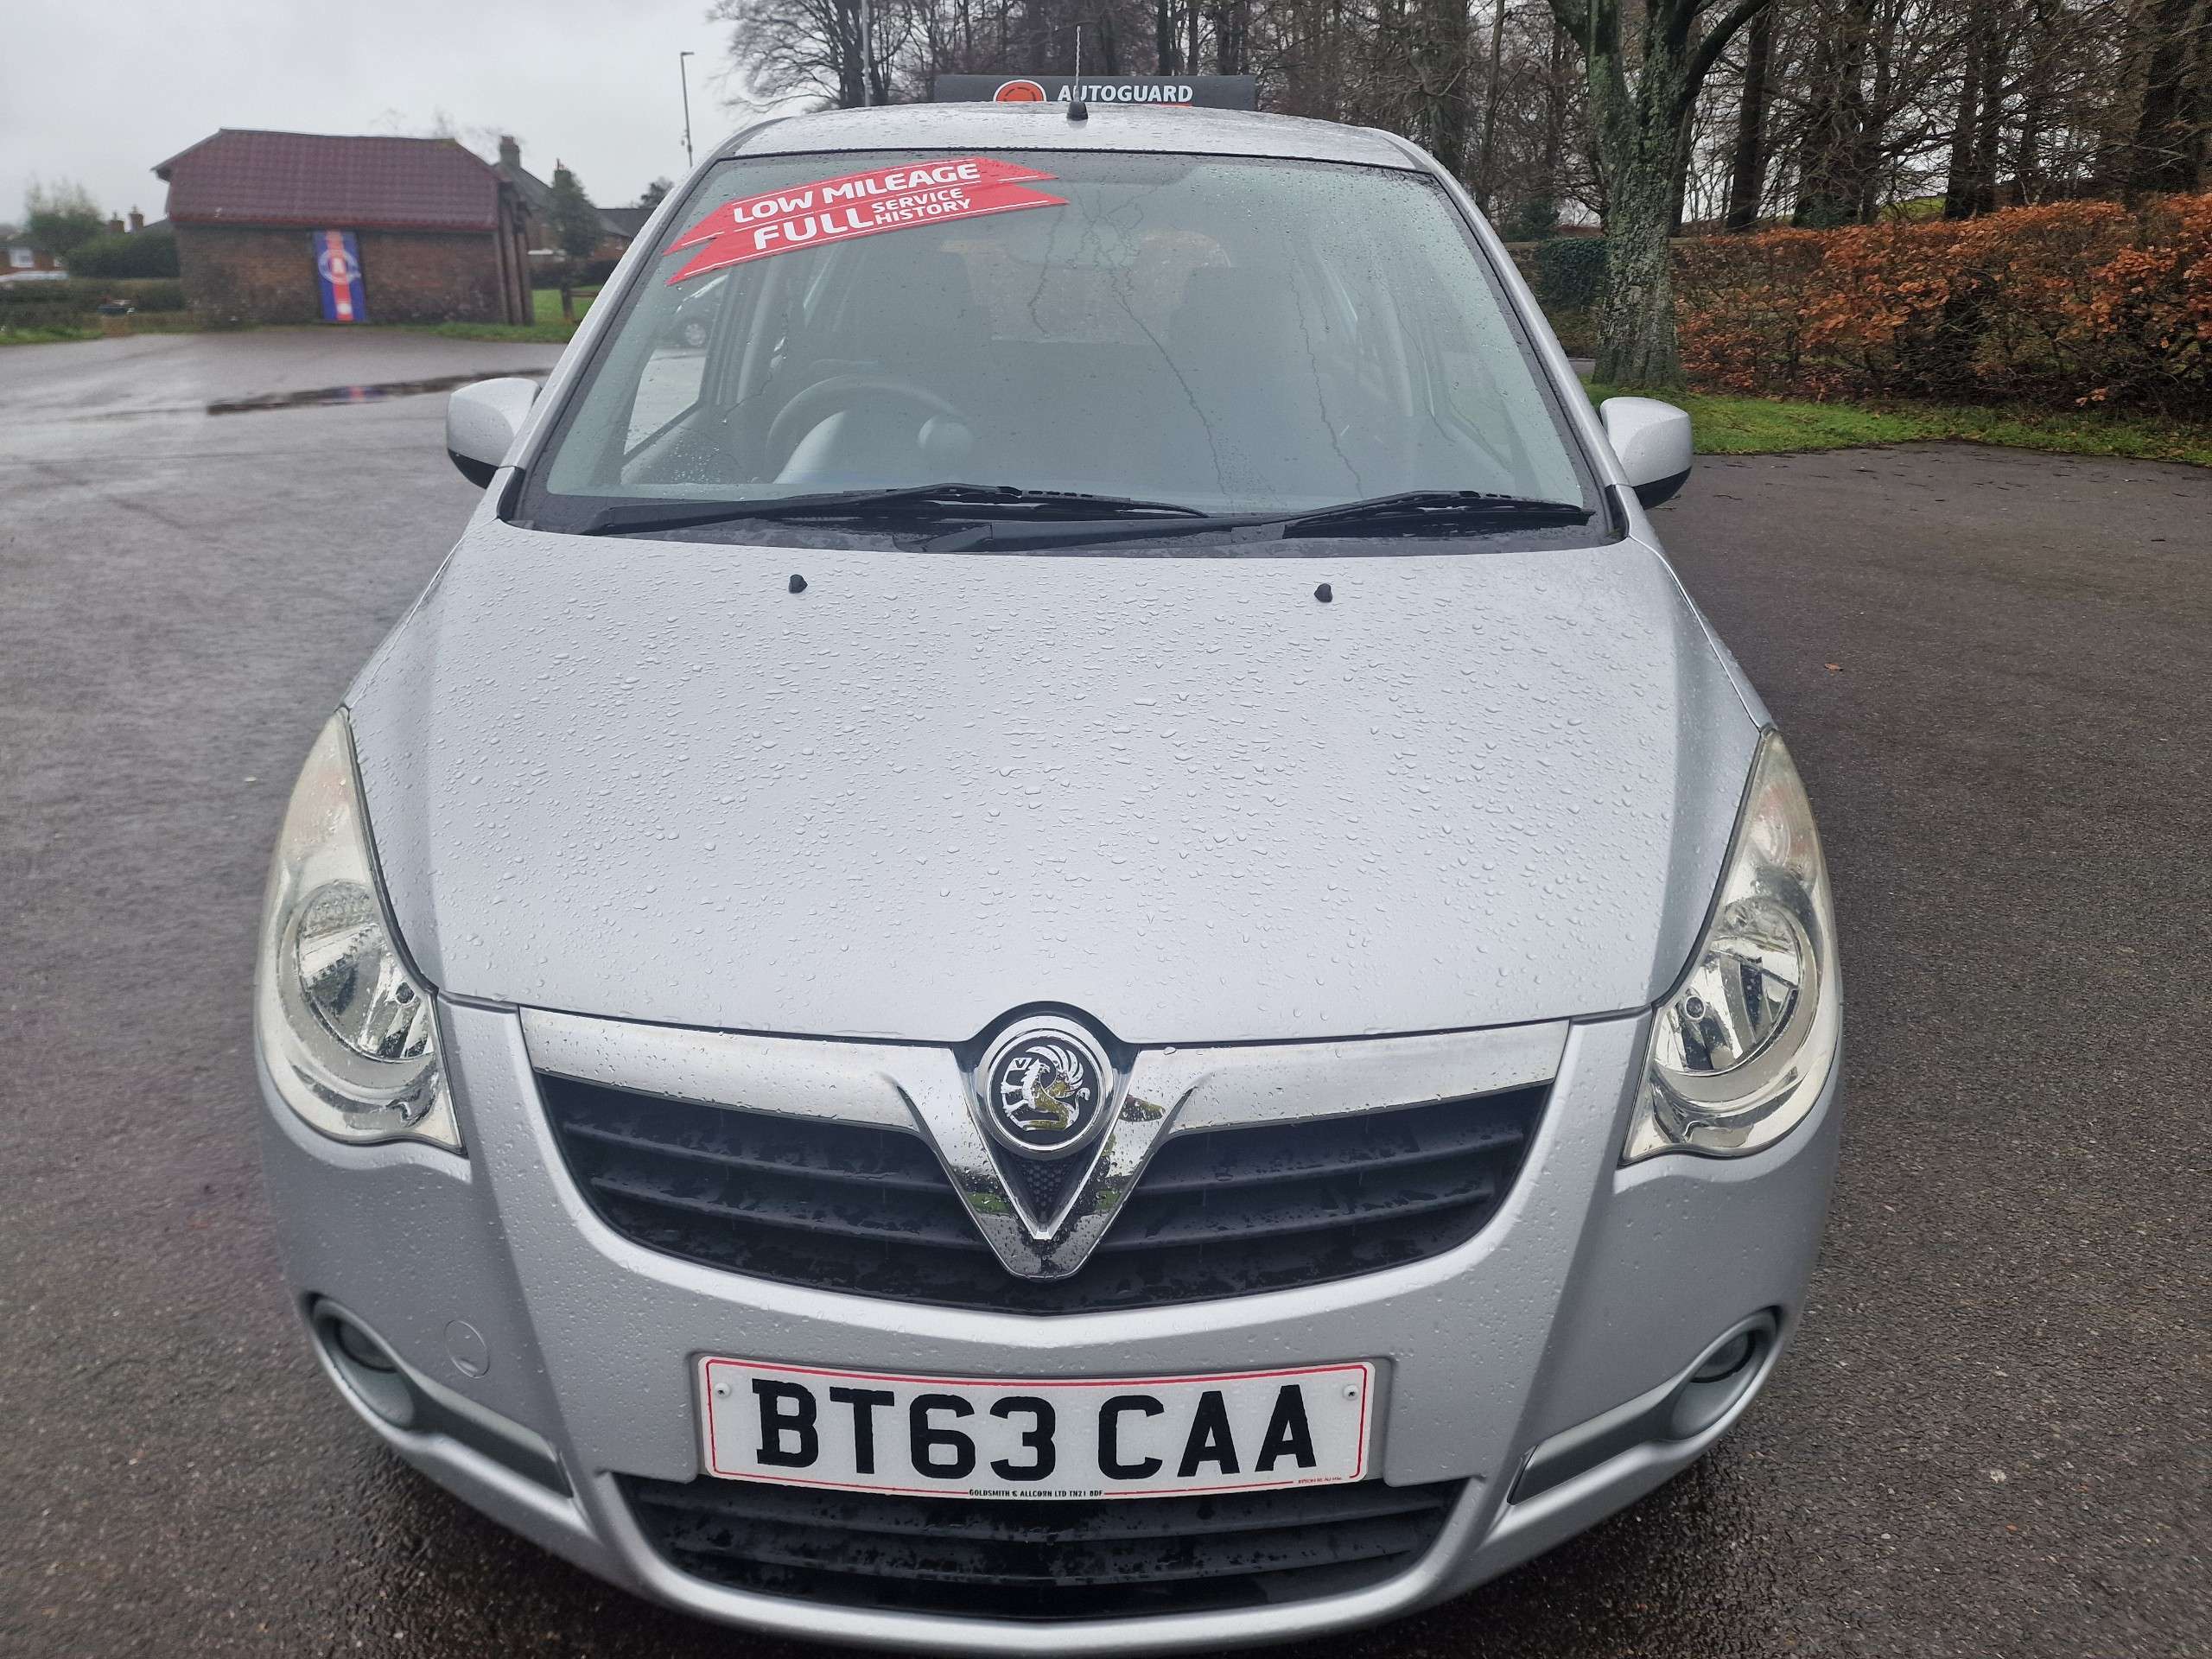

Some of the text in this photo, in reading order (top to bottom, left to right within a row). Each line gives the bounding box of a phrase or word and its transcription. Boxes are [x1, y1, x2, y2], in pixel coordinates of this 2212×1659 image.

[1057, 85, 1193, 103] AUTOGUARD
[733, 162, 981, 223] LOW MILEAGE
[872, 188, 963, 213] SERVICE
[875, 198, 971, 225] HISTORY
[753, 208, 874, 250] FULL
[752, 1378, 1317, 1481] BT63 CAA
